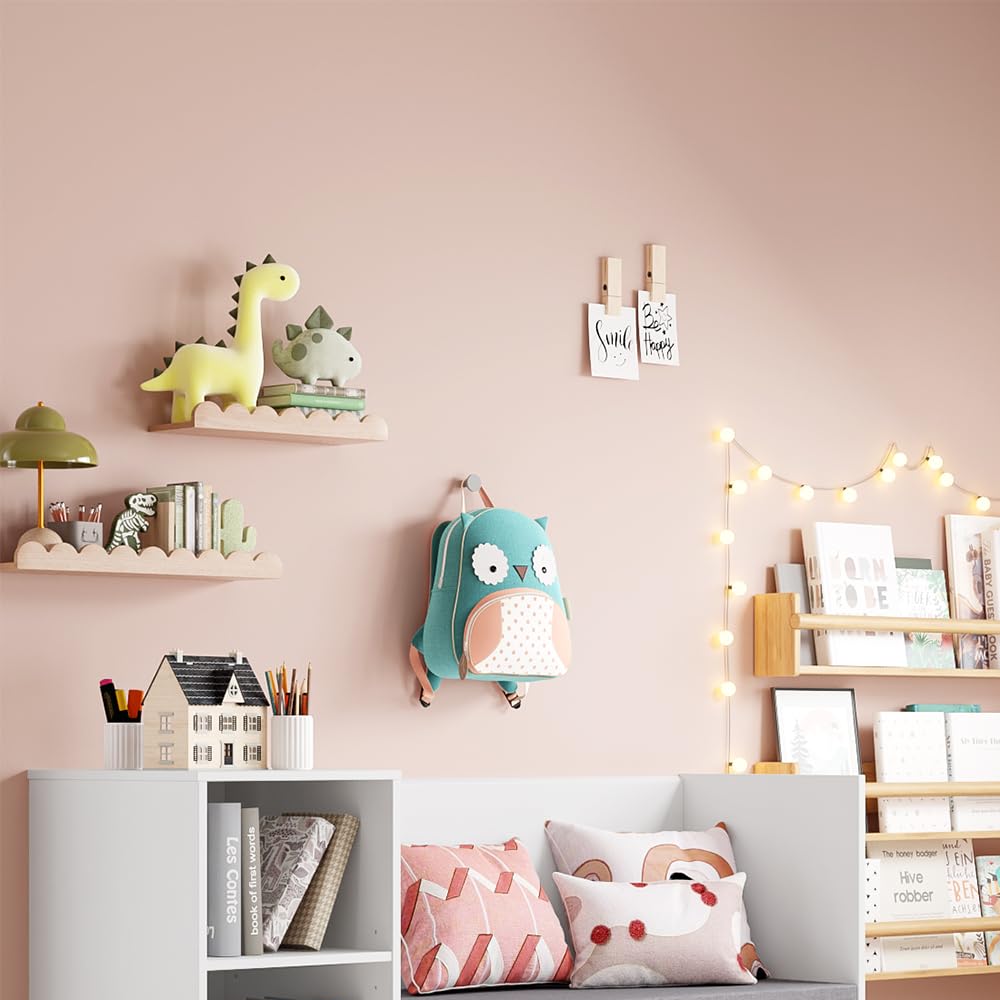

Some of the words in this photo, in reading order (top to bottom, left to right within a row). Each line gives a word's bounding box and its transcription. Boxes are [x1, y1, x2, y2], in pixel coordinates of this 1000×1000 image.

[643, 332, 675, 360] Happy
[984, 559, 993, 587] BABY
[986, 590, 995, 620] GUES
[989, 635, 998, 661] OOK
[226, 836, 239, 864] Les
[248, 826, 256, 862] words
[882, 850, 894, 858] The
[896, 850, 913, 859] honey
[916, 849, 938, 858] badger
[248, 863, 257, 886] first
[899, 871, 924, 884] Hive
[249, 887, 258, 903] of
[893, 889, 934, 903] robber
[250, 904, 259, 936] book
